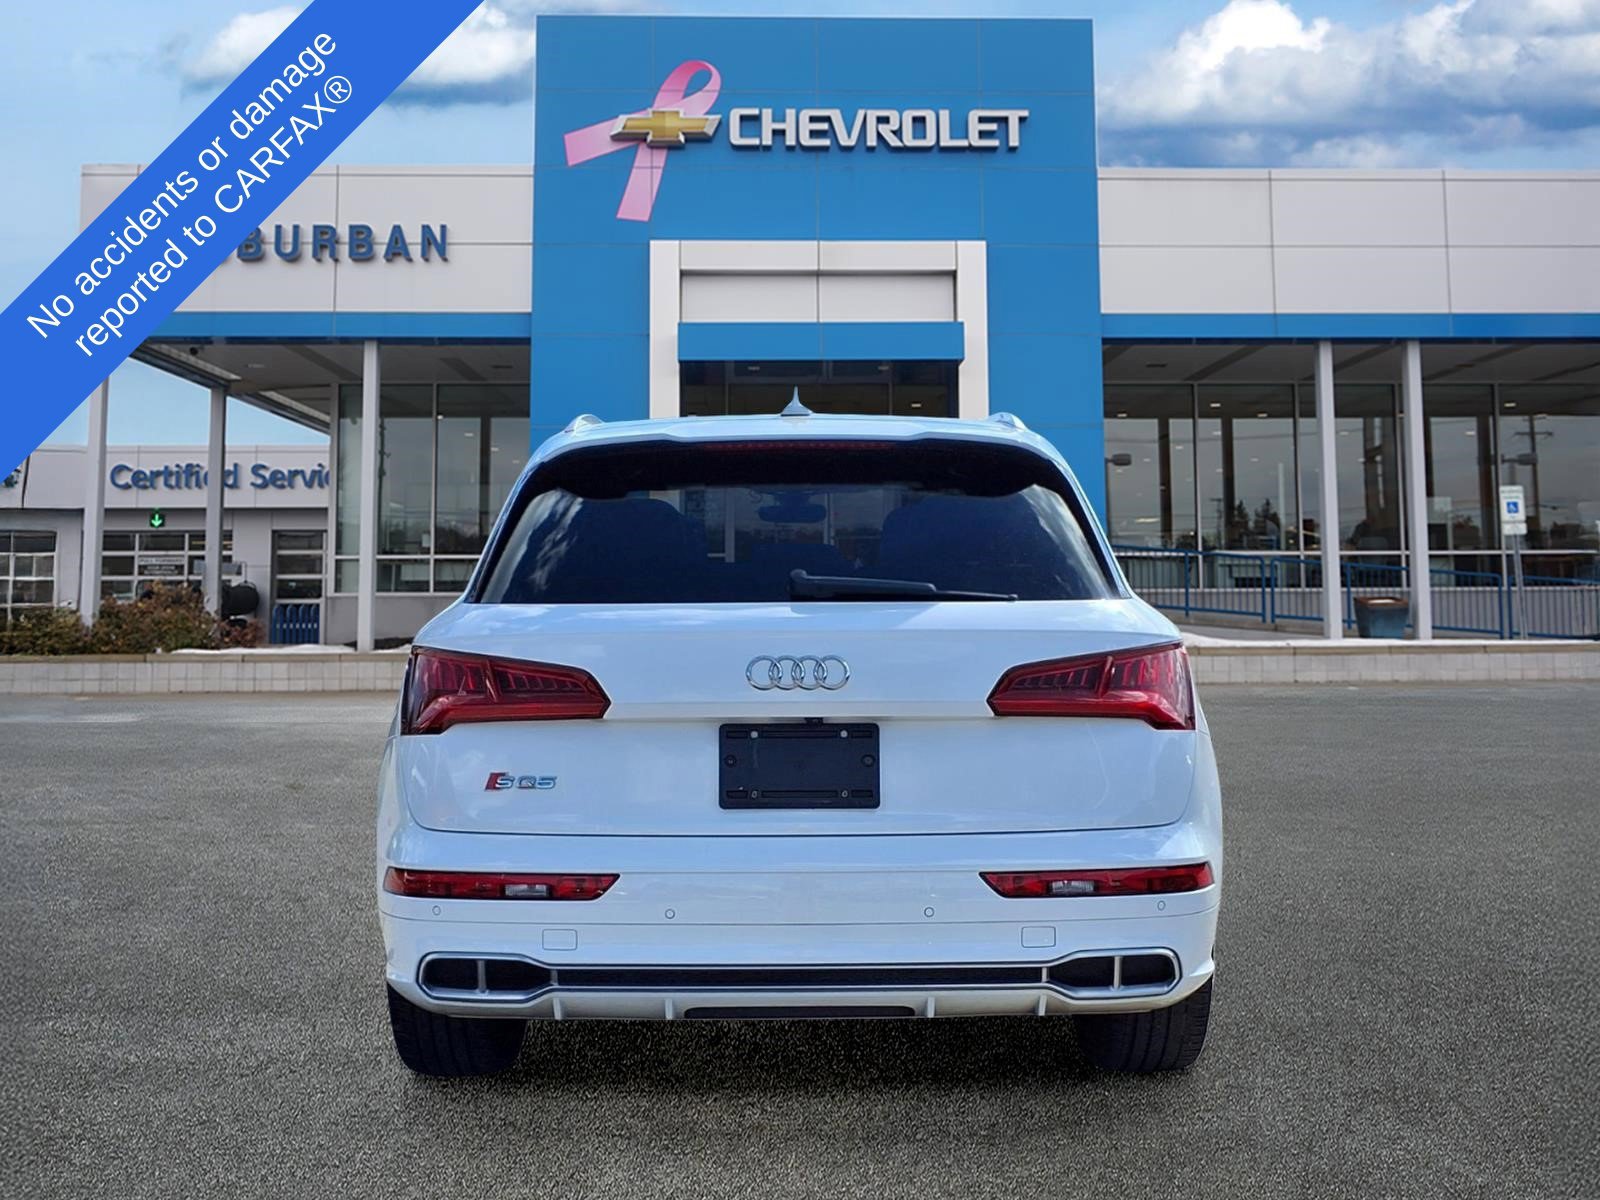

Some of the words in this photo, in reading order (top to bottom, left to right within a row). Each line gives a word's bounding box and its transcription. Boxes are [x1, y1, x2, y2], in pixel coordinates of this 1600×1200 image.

[728, 107, 1029, 149] CHEVROLET
[110, 463, 240, 490] Certifid
[489, 772, 558, 790] SQ5
